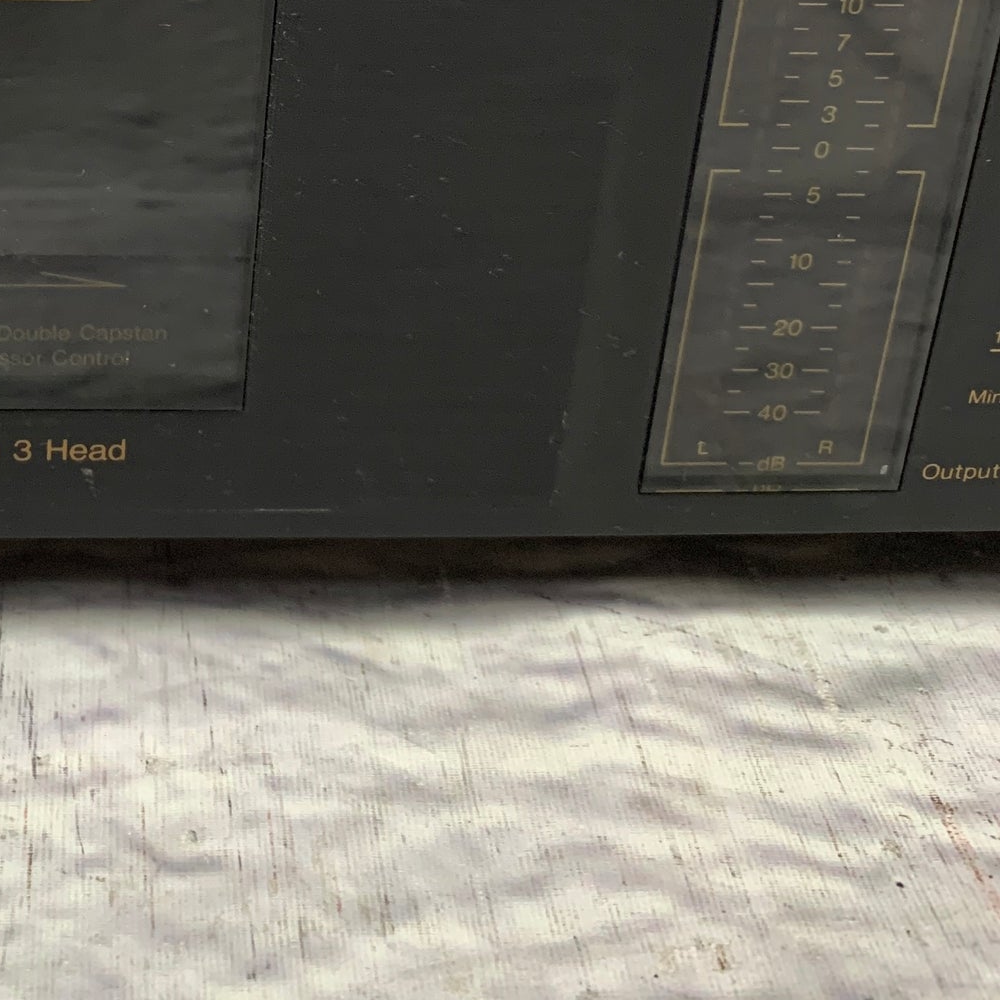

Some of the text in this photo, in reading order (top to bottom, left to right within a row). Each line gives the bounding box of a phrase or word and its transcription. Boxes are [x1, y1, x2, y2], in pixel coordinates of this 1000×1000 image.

[836, 33, 851, 52] 7
[827, 68, 843, 88] 5
[820, 105, 838, 124] 3
[813, 141, 830, 160] 0
[805, 186, 821, 205] 5
[788, 253, 813, 271] 10
[78, 324, 168, 347] Capstan
[772, 319, 804, 337] 20
[51, 350, 131, 367] Control
[764, 362, 795, 379] 30
[757, 404, 788, 422] 40
[12, 440, 33, 461] 3
[45, 438, 127, 461] Head
[818, 440, 834, 455] R
[922, 463, 1000, 483] Output
